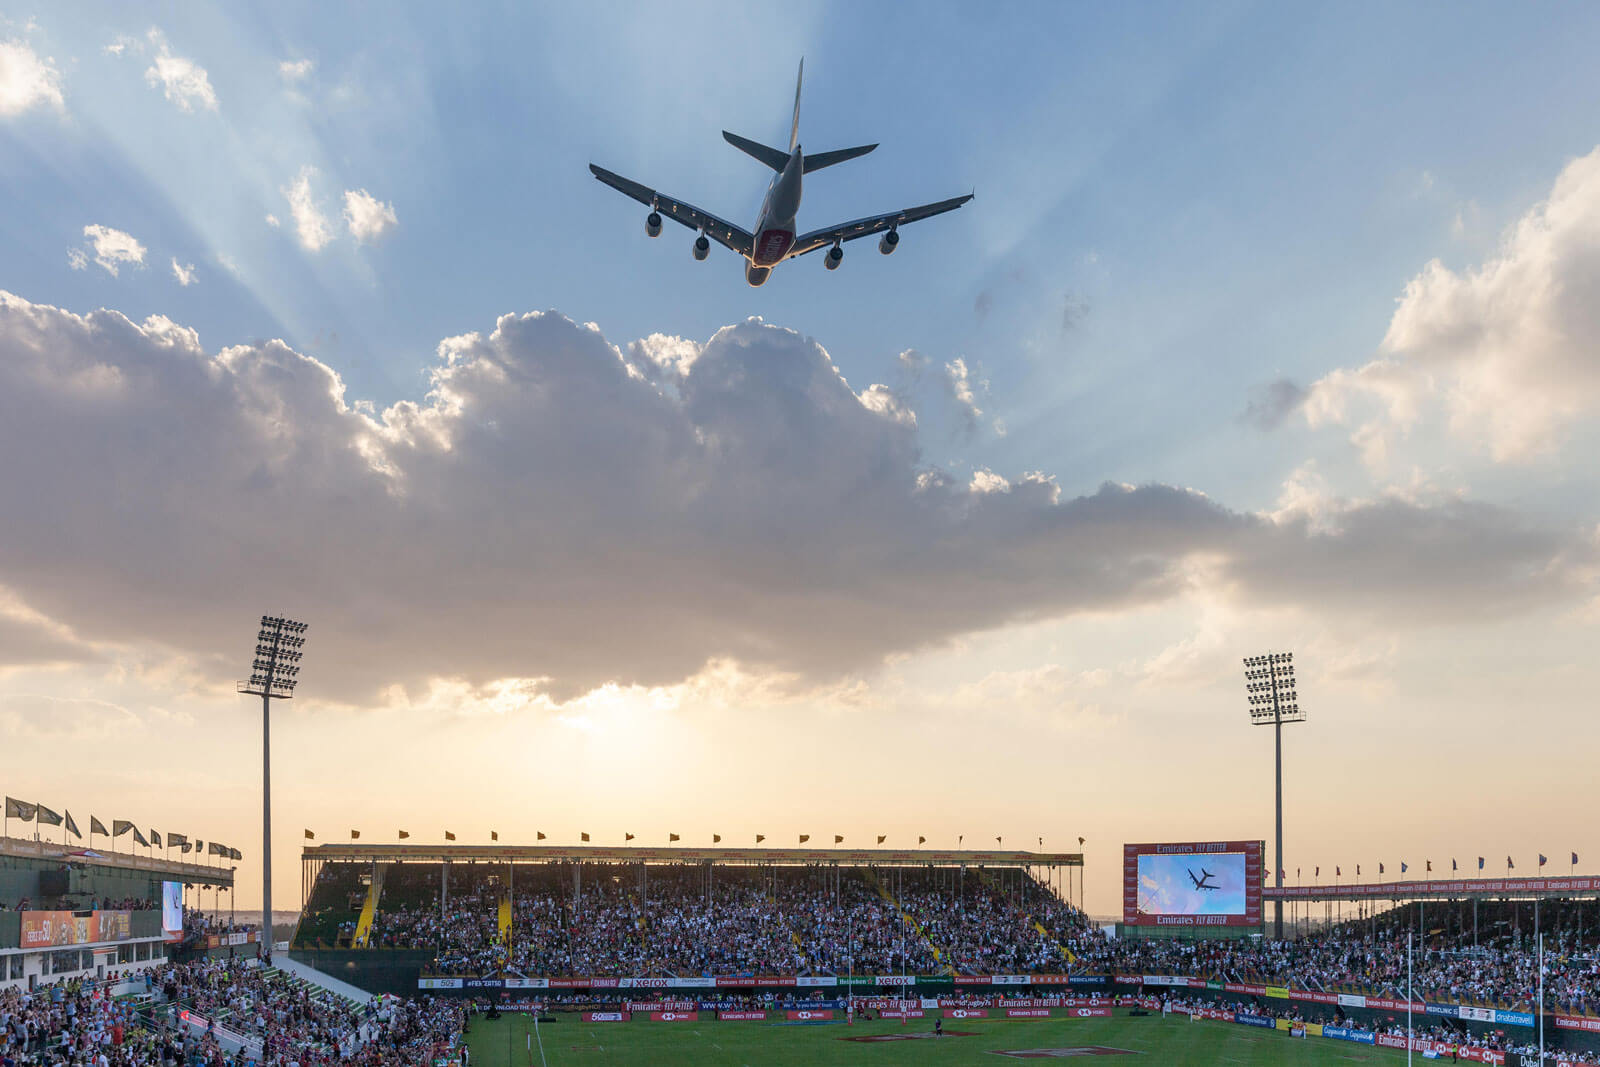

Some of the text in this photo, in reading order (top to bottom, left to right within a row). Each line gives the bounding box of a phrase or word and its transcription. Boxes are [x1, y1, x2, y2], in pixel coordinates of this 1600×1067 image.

[1157, 844, 1193, 853] Emirates
[1157, 915, 1227, 925] Emirates FLY BETTER
[636, 979, 668, 987] xerox
[878, 977, 909, 985] xerox
[998, 999, 1031, 1008] Emirates
[1556, 1017, 1580, 1028] Emirates
[1379, 1034, 1406, 1049] Emirates
